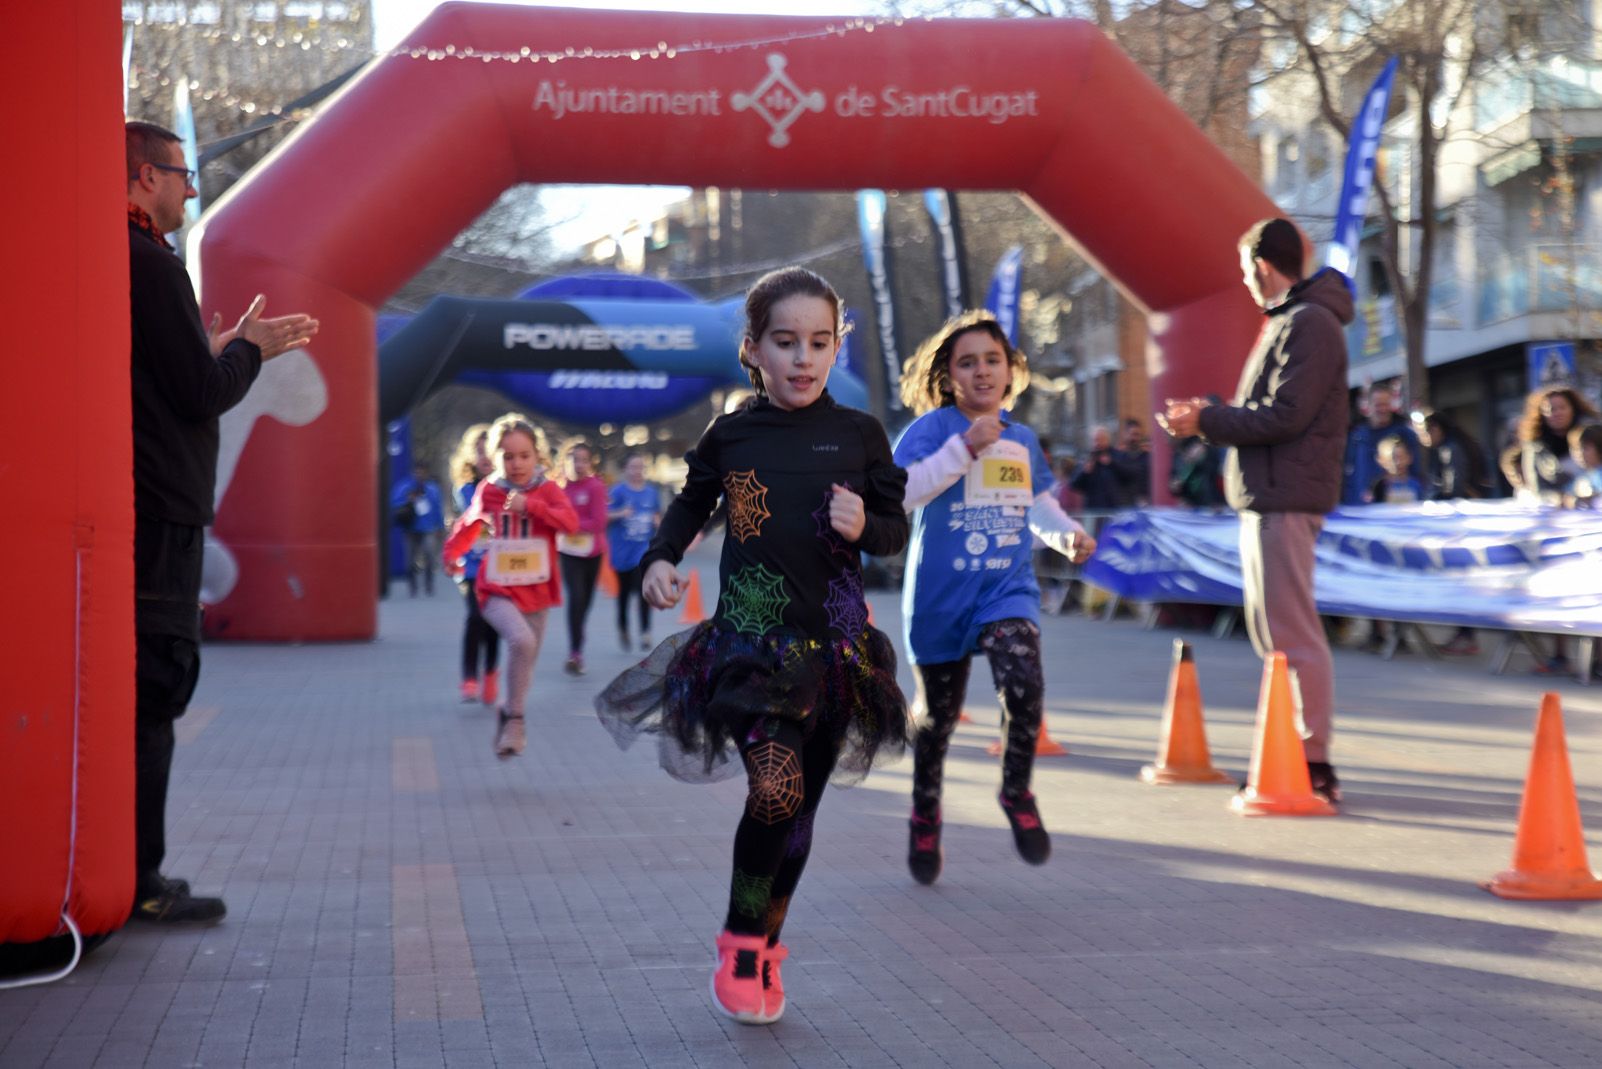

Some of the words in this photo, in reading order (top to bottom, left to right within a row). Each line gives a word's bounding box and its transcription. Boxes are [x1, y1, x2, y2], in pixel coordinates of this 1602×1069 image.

[534, 80, 721, 120] Ajuntament
[835, 85, 877, 117] de
[882, 86, 1038, 125] SantCugat
[503, 323, 697, 349] POWERADE
